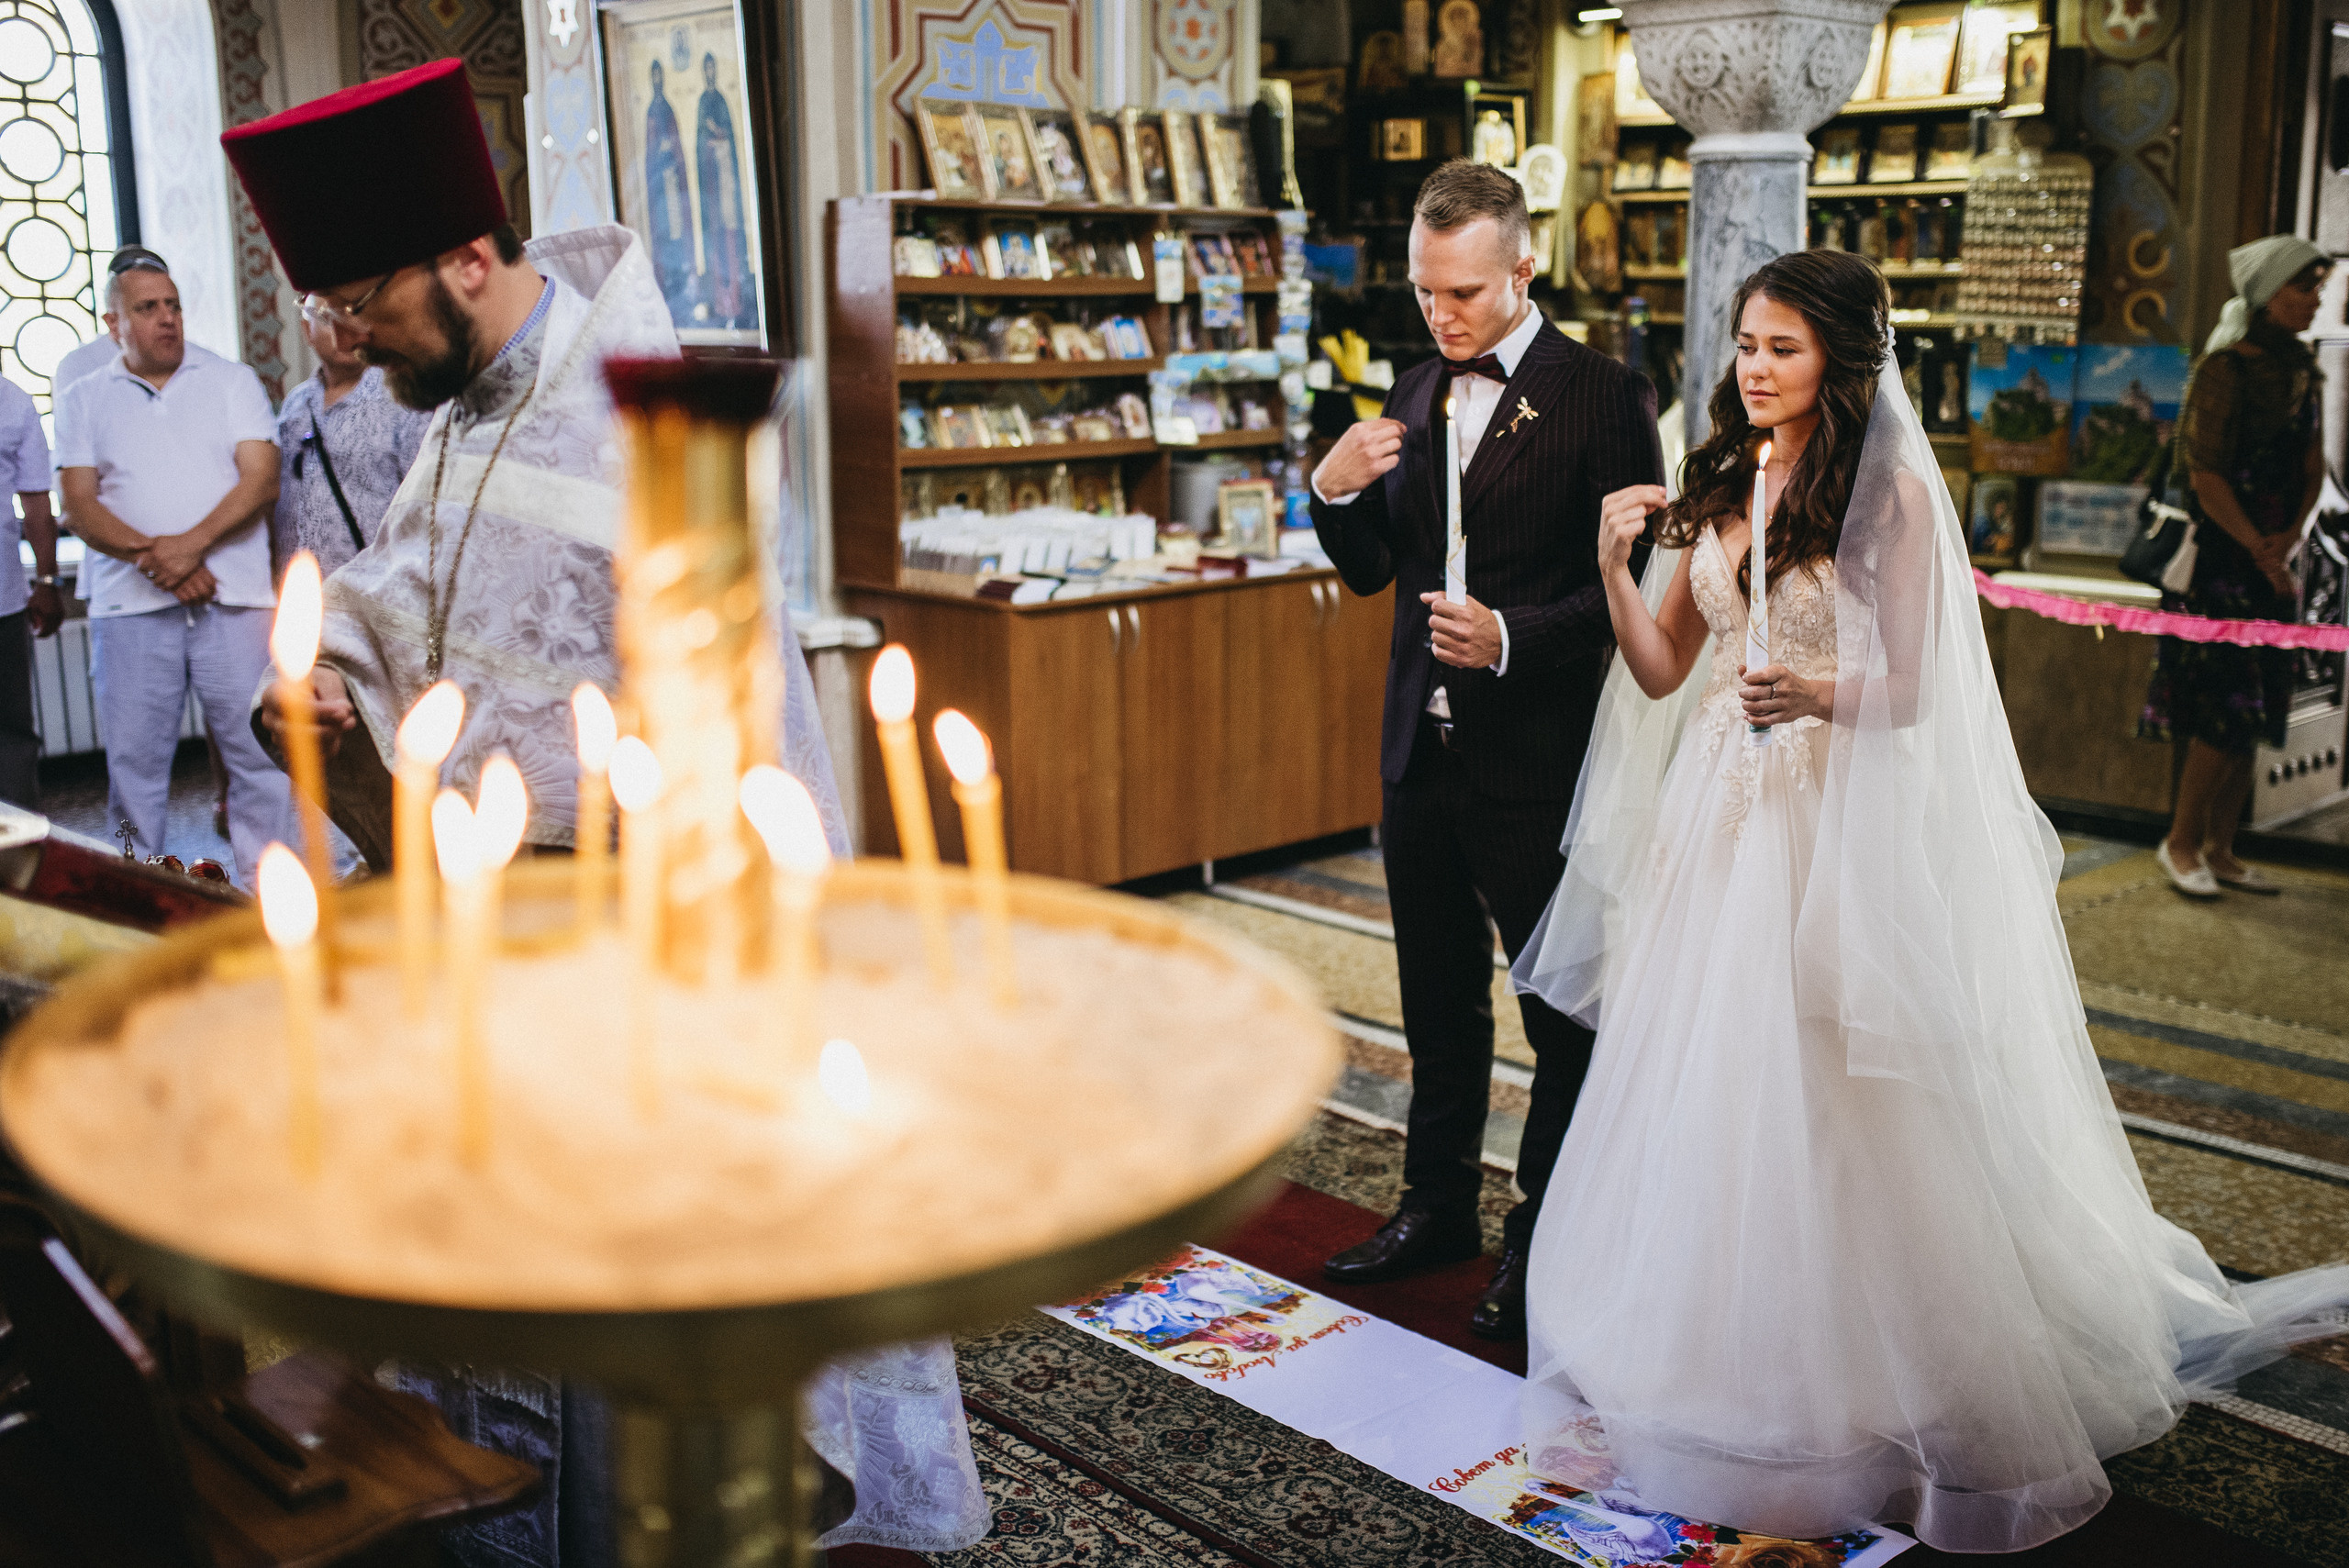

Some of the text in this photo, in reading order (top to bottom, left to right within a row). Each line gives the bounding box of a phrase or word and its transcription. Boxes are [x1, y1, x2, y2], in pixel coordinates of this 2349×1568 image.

[1308, 1315, 1370, 1340] Совет
[1286, 1336, 1308, 1352] да
[1428, 1446, 1520, 1493] Совет да
